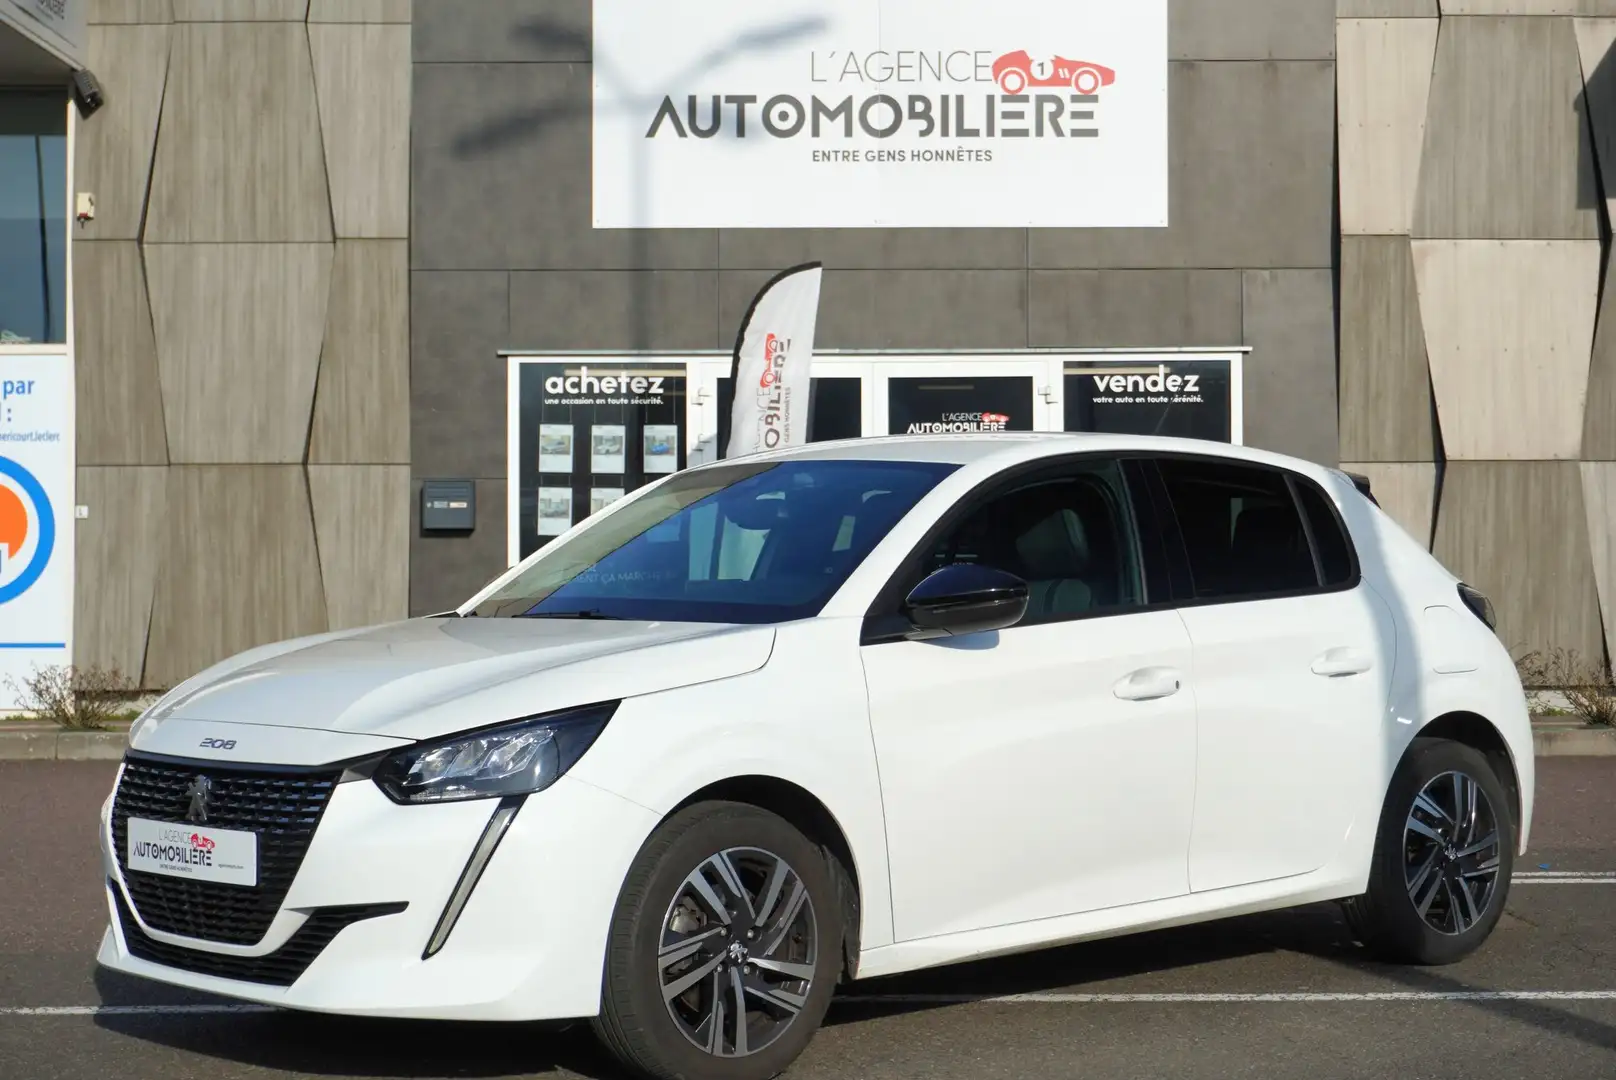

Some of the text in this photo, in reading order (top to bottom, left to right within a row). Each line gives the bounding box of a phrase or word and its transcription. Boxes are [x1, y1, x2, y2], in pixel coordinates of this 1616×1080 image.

[811, 50, 993, 82] L'AGENCE
[812, 145, 993, 163] ENTRE GENS HONNÊTES
[544, 365, 665, 394] achetez
[1092, 363, 1200, 393] vendez
[3, 380, 35, 400] par
[1115, 395, 1134, 403] auto
[1147, 395, 1168, 403] toute
[561, 396, 594, 405] occasion
[608, 397, 629, 405] toute
[941, 412, 983, 422] L'AGENCE
[199, 737, 237, 750] 208
